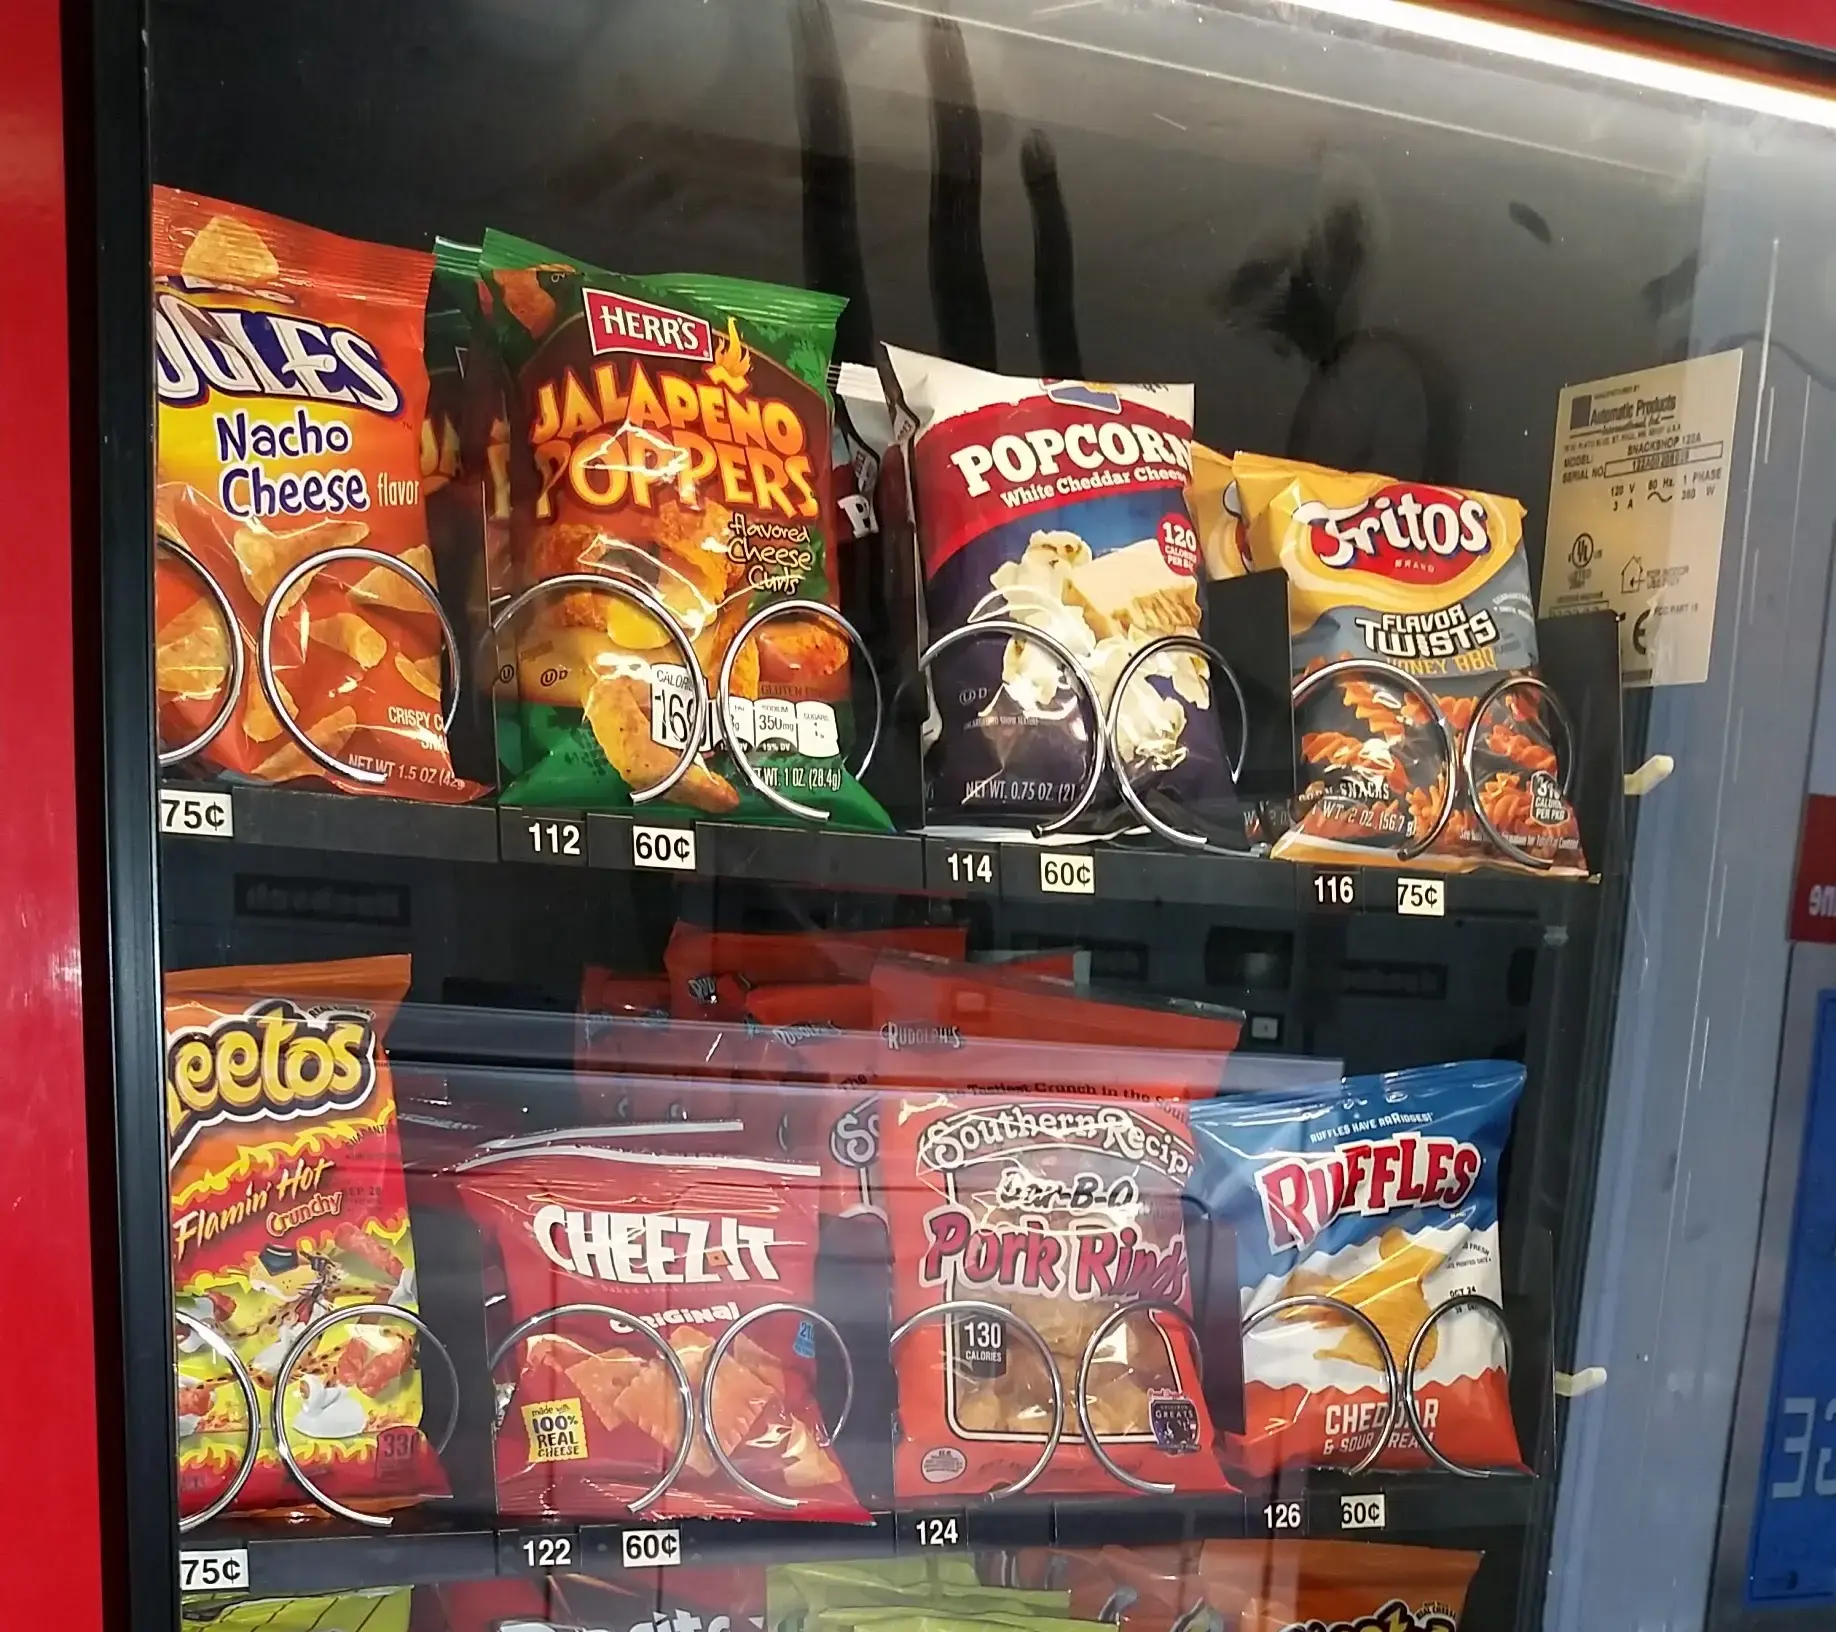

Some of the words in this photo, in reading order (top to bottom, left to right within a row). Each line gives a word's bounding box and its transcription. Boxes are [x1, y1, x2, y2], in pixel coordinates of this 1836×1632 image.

[601, 306, 700, 352] HERR'S
[217, 410, 350, 459] Nacho
[535, 430, 819, 519] POPPERS
[952, 421, 1192, 498] POPCORN
[221, 464, 369, 518] Cheese
[377, 471, 419, 508] flavor
[1000, 483, 1056, 511] White
[1059, 470, 1131, 498] Cheddar
[730, 513, 812, 543] flavored
[1163, 521, 1197, 552] 120
[1294, 492, 1489, 567] Fritos
[729, 536, 813, 572] Cheese
[1395, 559, 1435, 573] BRAND
[748, 564, 800, 595] Curls
[1382, 603, 1467, 633] FLAVOR
[1356, 609, 1498, 659] TWISTS
[388, 706, 430, 728] CRISPY
[375, 759, 395, 777] WT
[399, 765, 417, 780] 1.5
[420, 767, 437, 784] OZ
[966, 780, 987, 800] NET
[990, 781, 1008, 800] WT.
[1011, 781, 1035, 801] 0.75
[162, 798, 226, 831] 75¢
[529, 822, 581, 857] 112
[635, 829, 692, 862] 60¢
[947, 853, 994, 885] 114
[1044, 859, 1092, 888] 60¢
[1314, 876, 1355, 904] 116
[1398, 884, 1438, 907] 75¢
[1036, 1083, 1097, 1096] Crunch
[1102, 1084, 1119, 1097] in
[1124, 1088, 1151, 1102] the
[922, 1107, 1098, 1170] Southern
[1310, 1126, 1351, 1143] RUFFLES
[1352, 1119, 1377, 1134] HAVE
[1258, 1134, 1480, 1248] RUFFLES
[172, 1182, 271, 1260] Flamin'
[275, 1157, 335, 1201] Hot
[266, 1188, 343, 1240] Crunchy
[920, 1208, 1064, 1294] Pork
[964, 1323, 1002, 1347] 130
[965, 1350, 1002, 1363] CALORIES
[532, 1415, 578, 1434] 100%
[537, 1430, 578, 1449] REAL
[538, 1445, 580, 1458] CHEESE
[1323, 1439, 1334, 1456] &
[1340, 1432, 1374, 1453] SOUR
[1263, 1503, 1301, 1529] 126
[1341, 1501, 1380, 1528] 60¢
[916, 1518, 959, 1546] 124
[523, 1538, 571, 1566] 122
[625, 1533, 680, 1562] 60¢
[181, 1557, 242, 1587] 75¢
